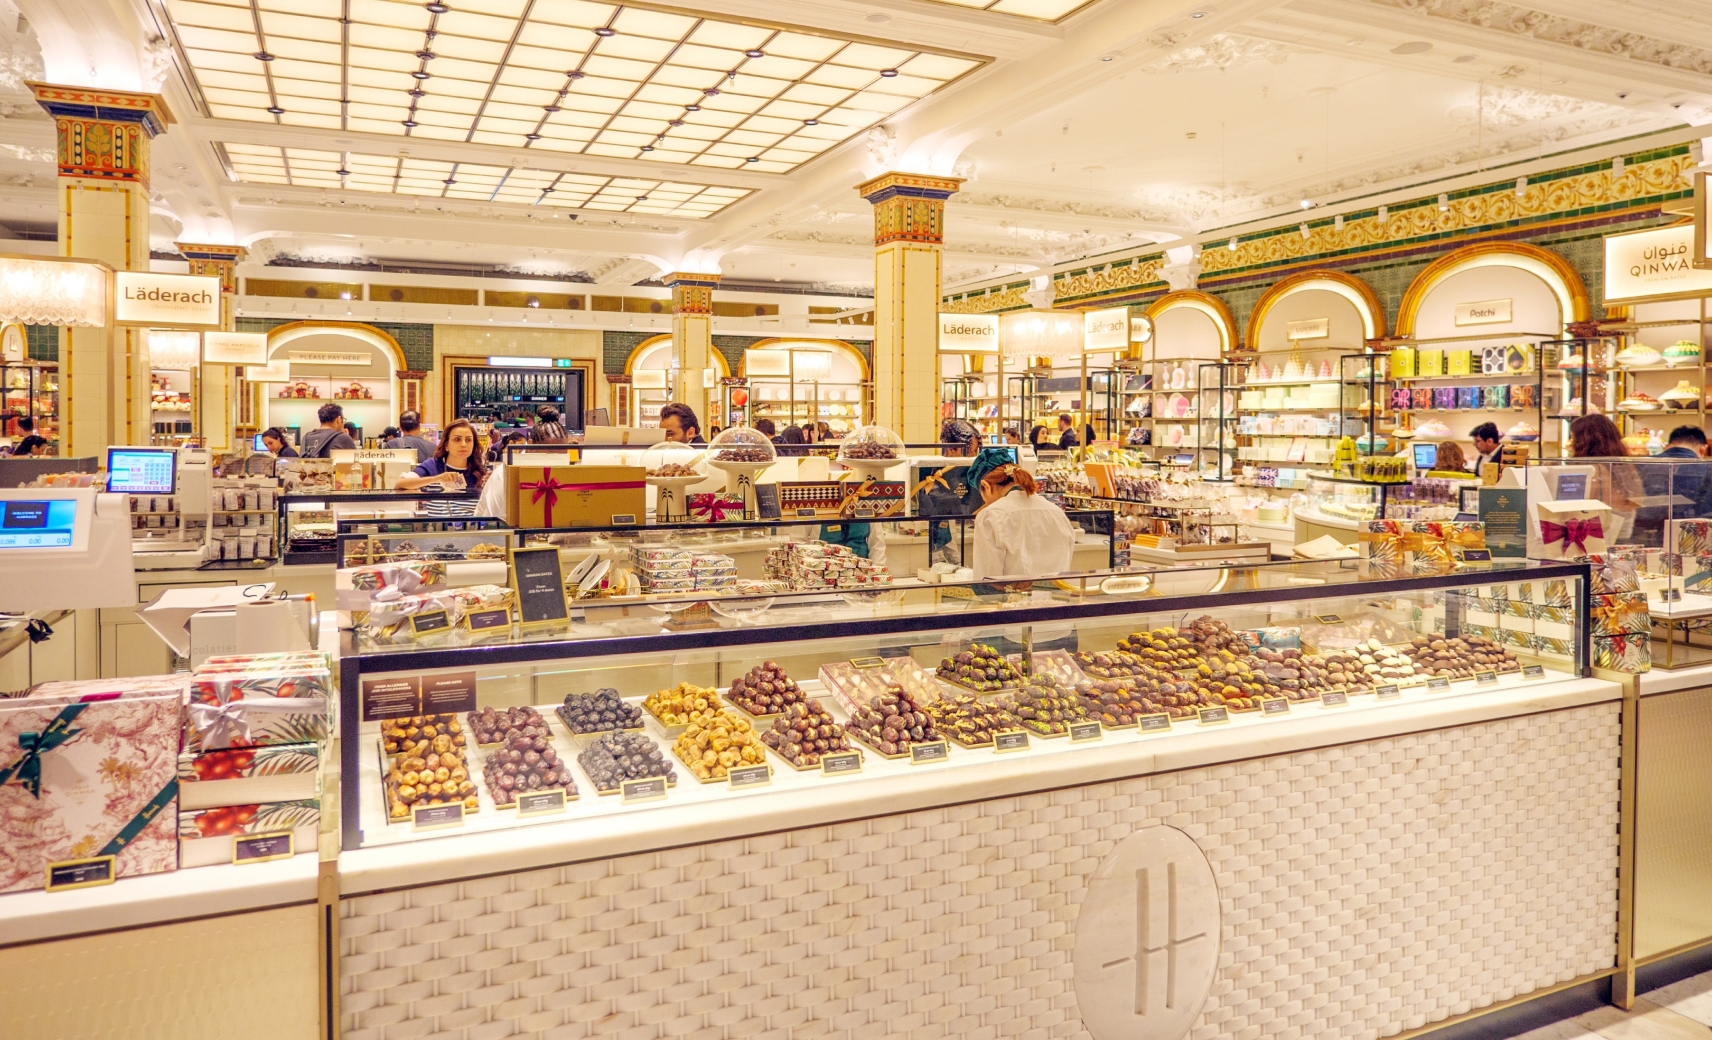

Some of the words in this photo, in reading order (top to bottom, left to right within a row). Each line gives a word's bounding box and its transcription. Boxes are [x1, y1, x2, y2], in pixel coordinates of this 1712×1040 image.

[1629, 258, 1690, 278] QINWA
[125, 286, 213, 304] Läderach
[1470, 308, 1496, 318] Patchi
[943, 323, 995, 336] Läderach
[1087, 319, 1125, 334] Läderach
[358, 451, 397, 460] äderach
